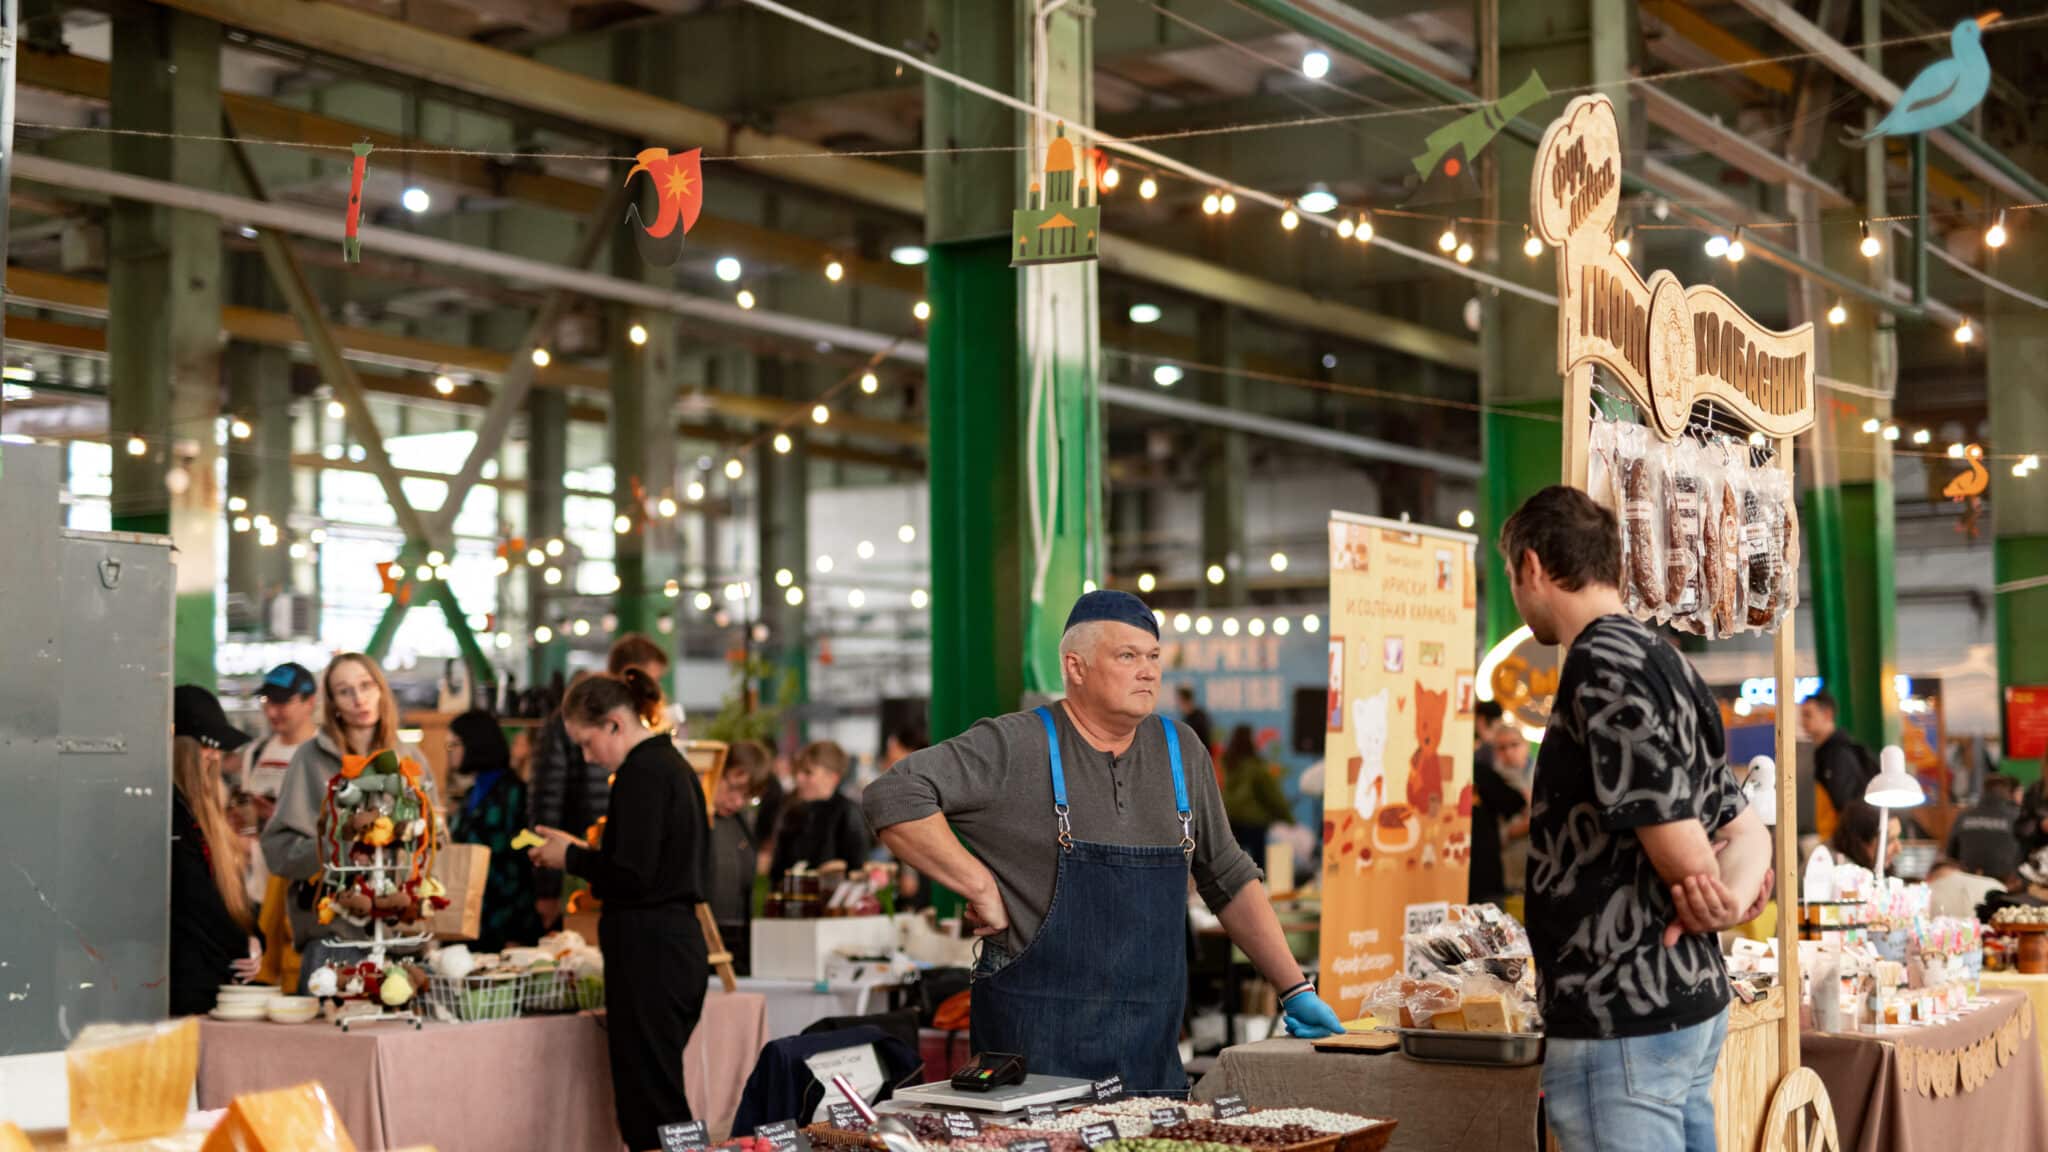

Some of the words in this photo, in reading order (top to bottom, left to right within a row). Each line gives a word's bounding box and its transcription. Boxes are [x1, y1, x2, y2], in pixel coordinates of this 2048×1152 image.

[1552, 135, 1587, 209] фуд
[1568, 157, 1615, 236] лавка
[1580, 265, 1646, 378] ГНОМ
[1693, 311, 1807, 417] КОЛБАСНИК
